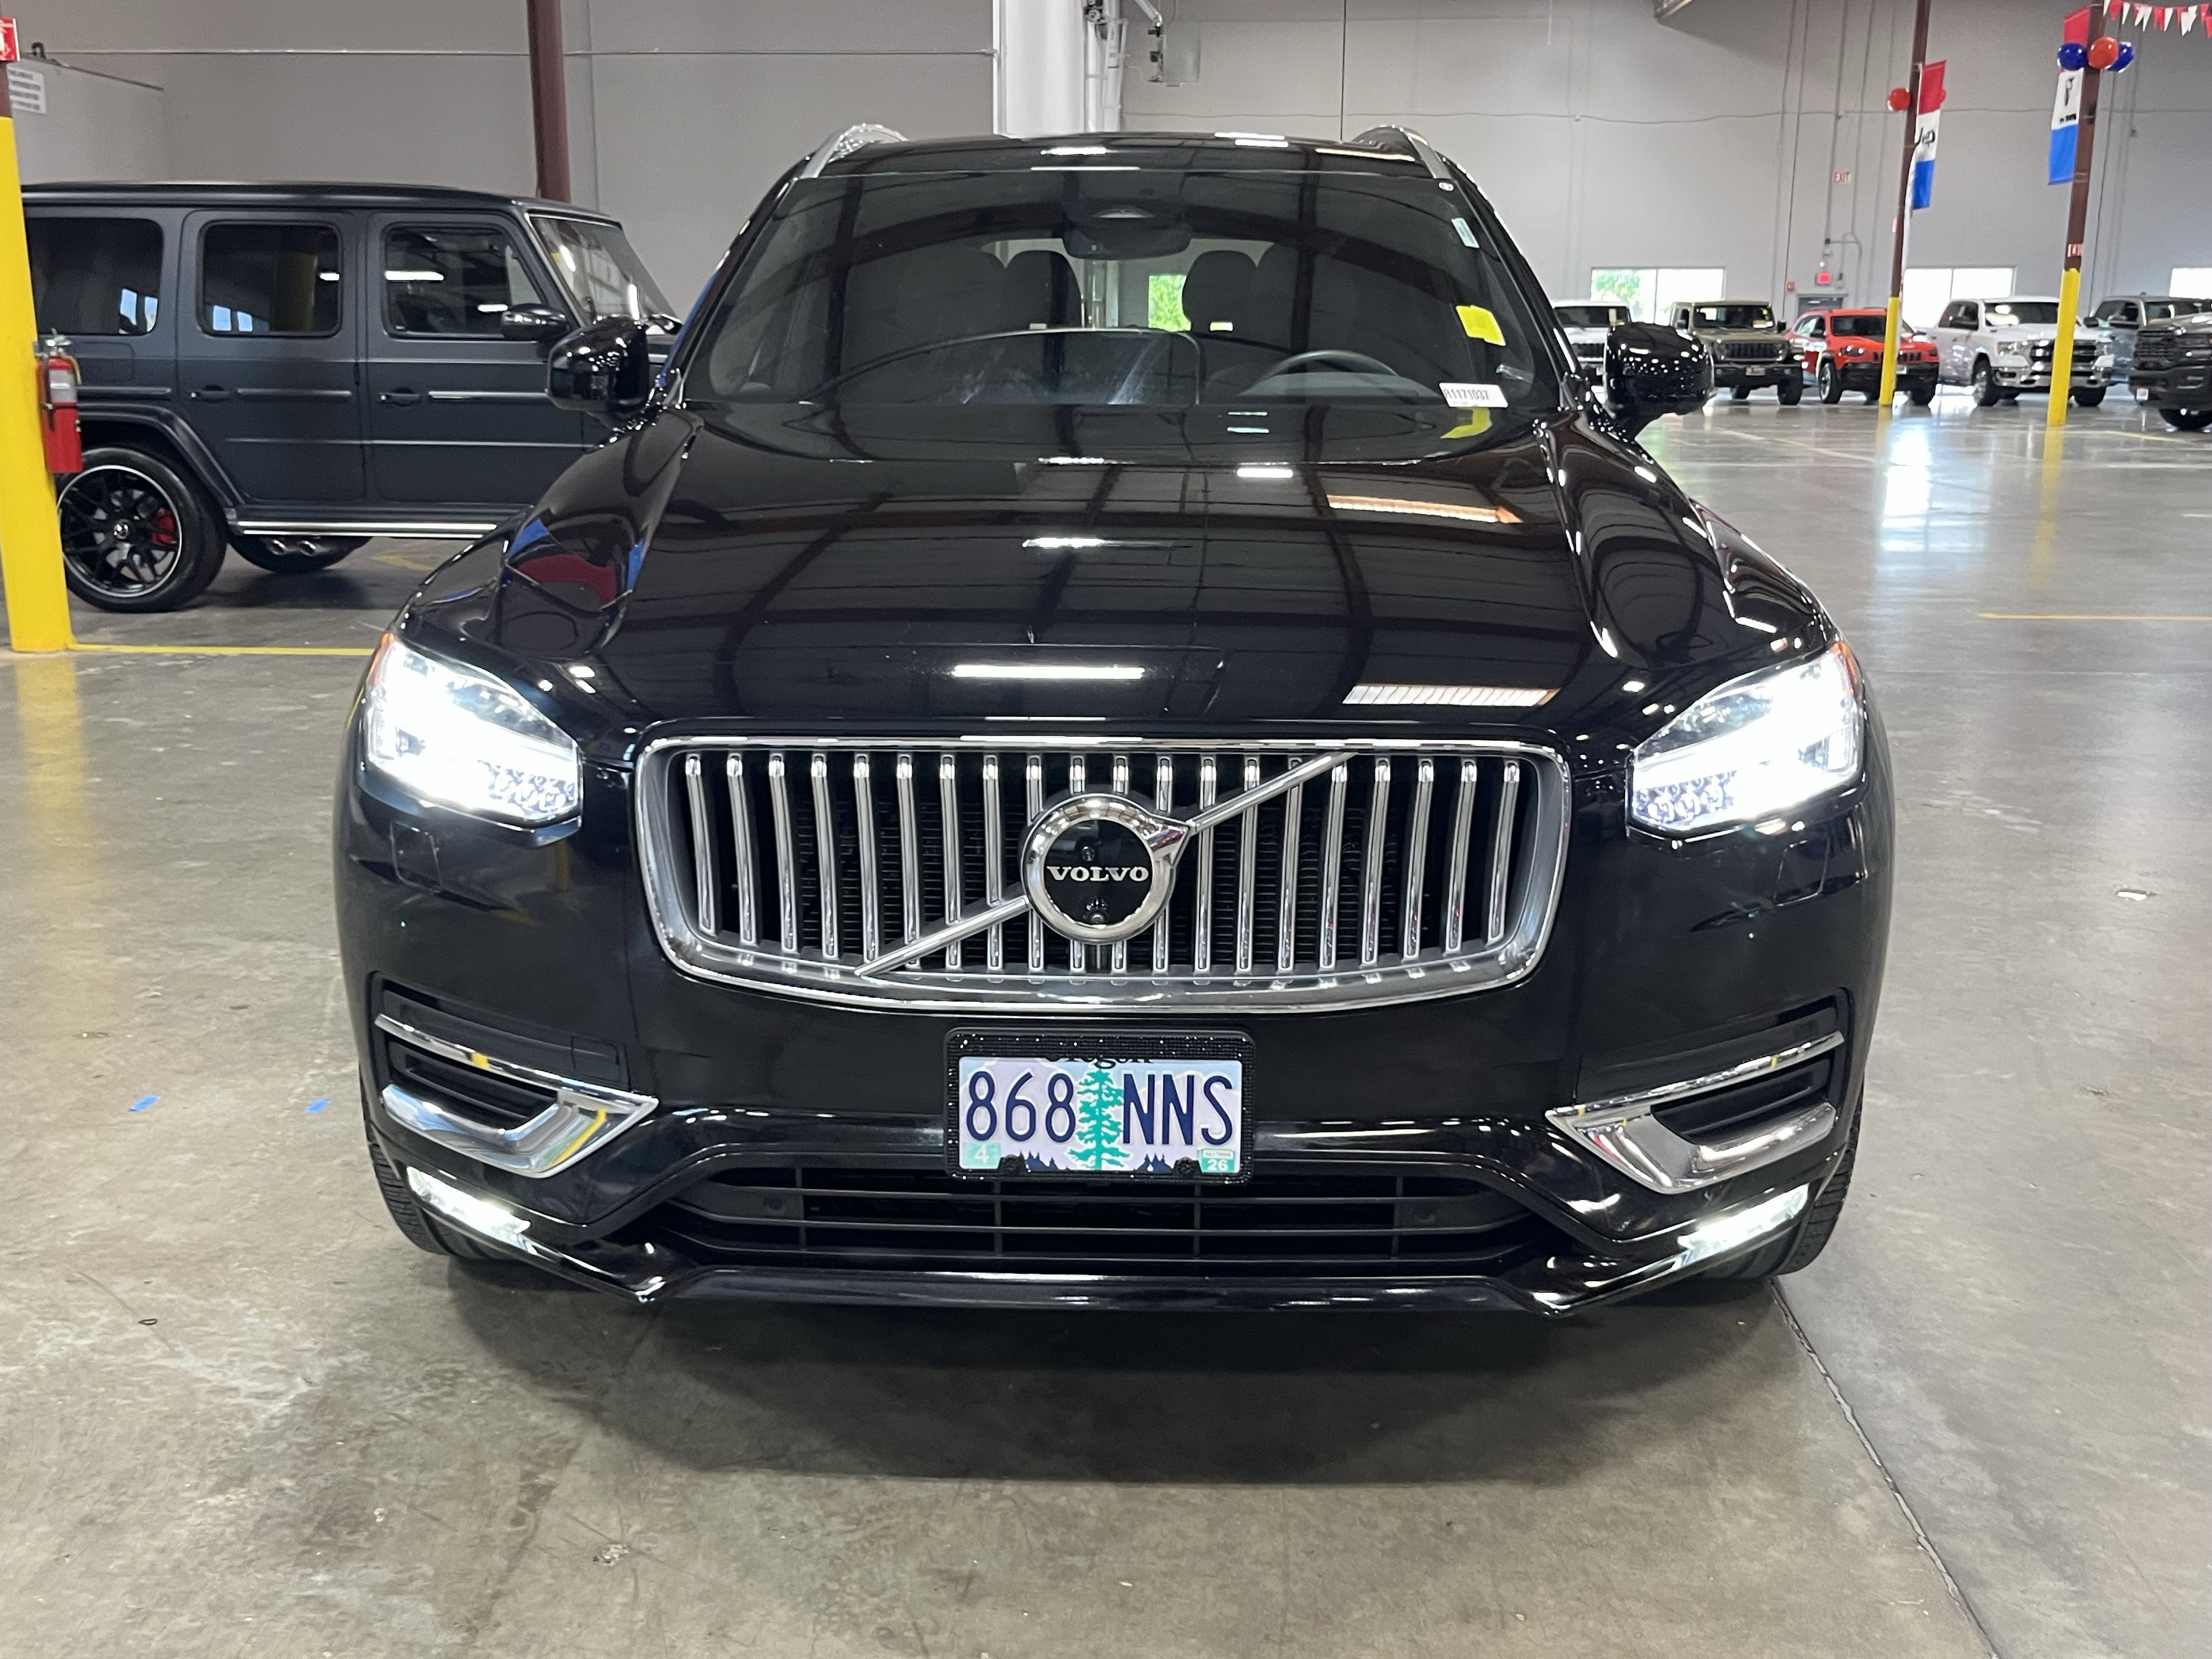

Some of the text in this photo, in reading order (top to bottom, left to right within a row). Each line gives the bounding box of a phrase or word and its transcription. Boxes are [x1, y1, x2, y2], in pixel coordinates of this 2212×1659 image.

[1046, 866, 1149, 881] VOLVO
[966, 1070, 1233, 1145] 868 NNS
[974, 1143, 989, 1163] 4
[1207, 1159, 1229, 1171] 26
